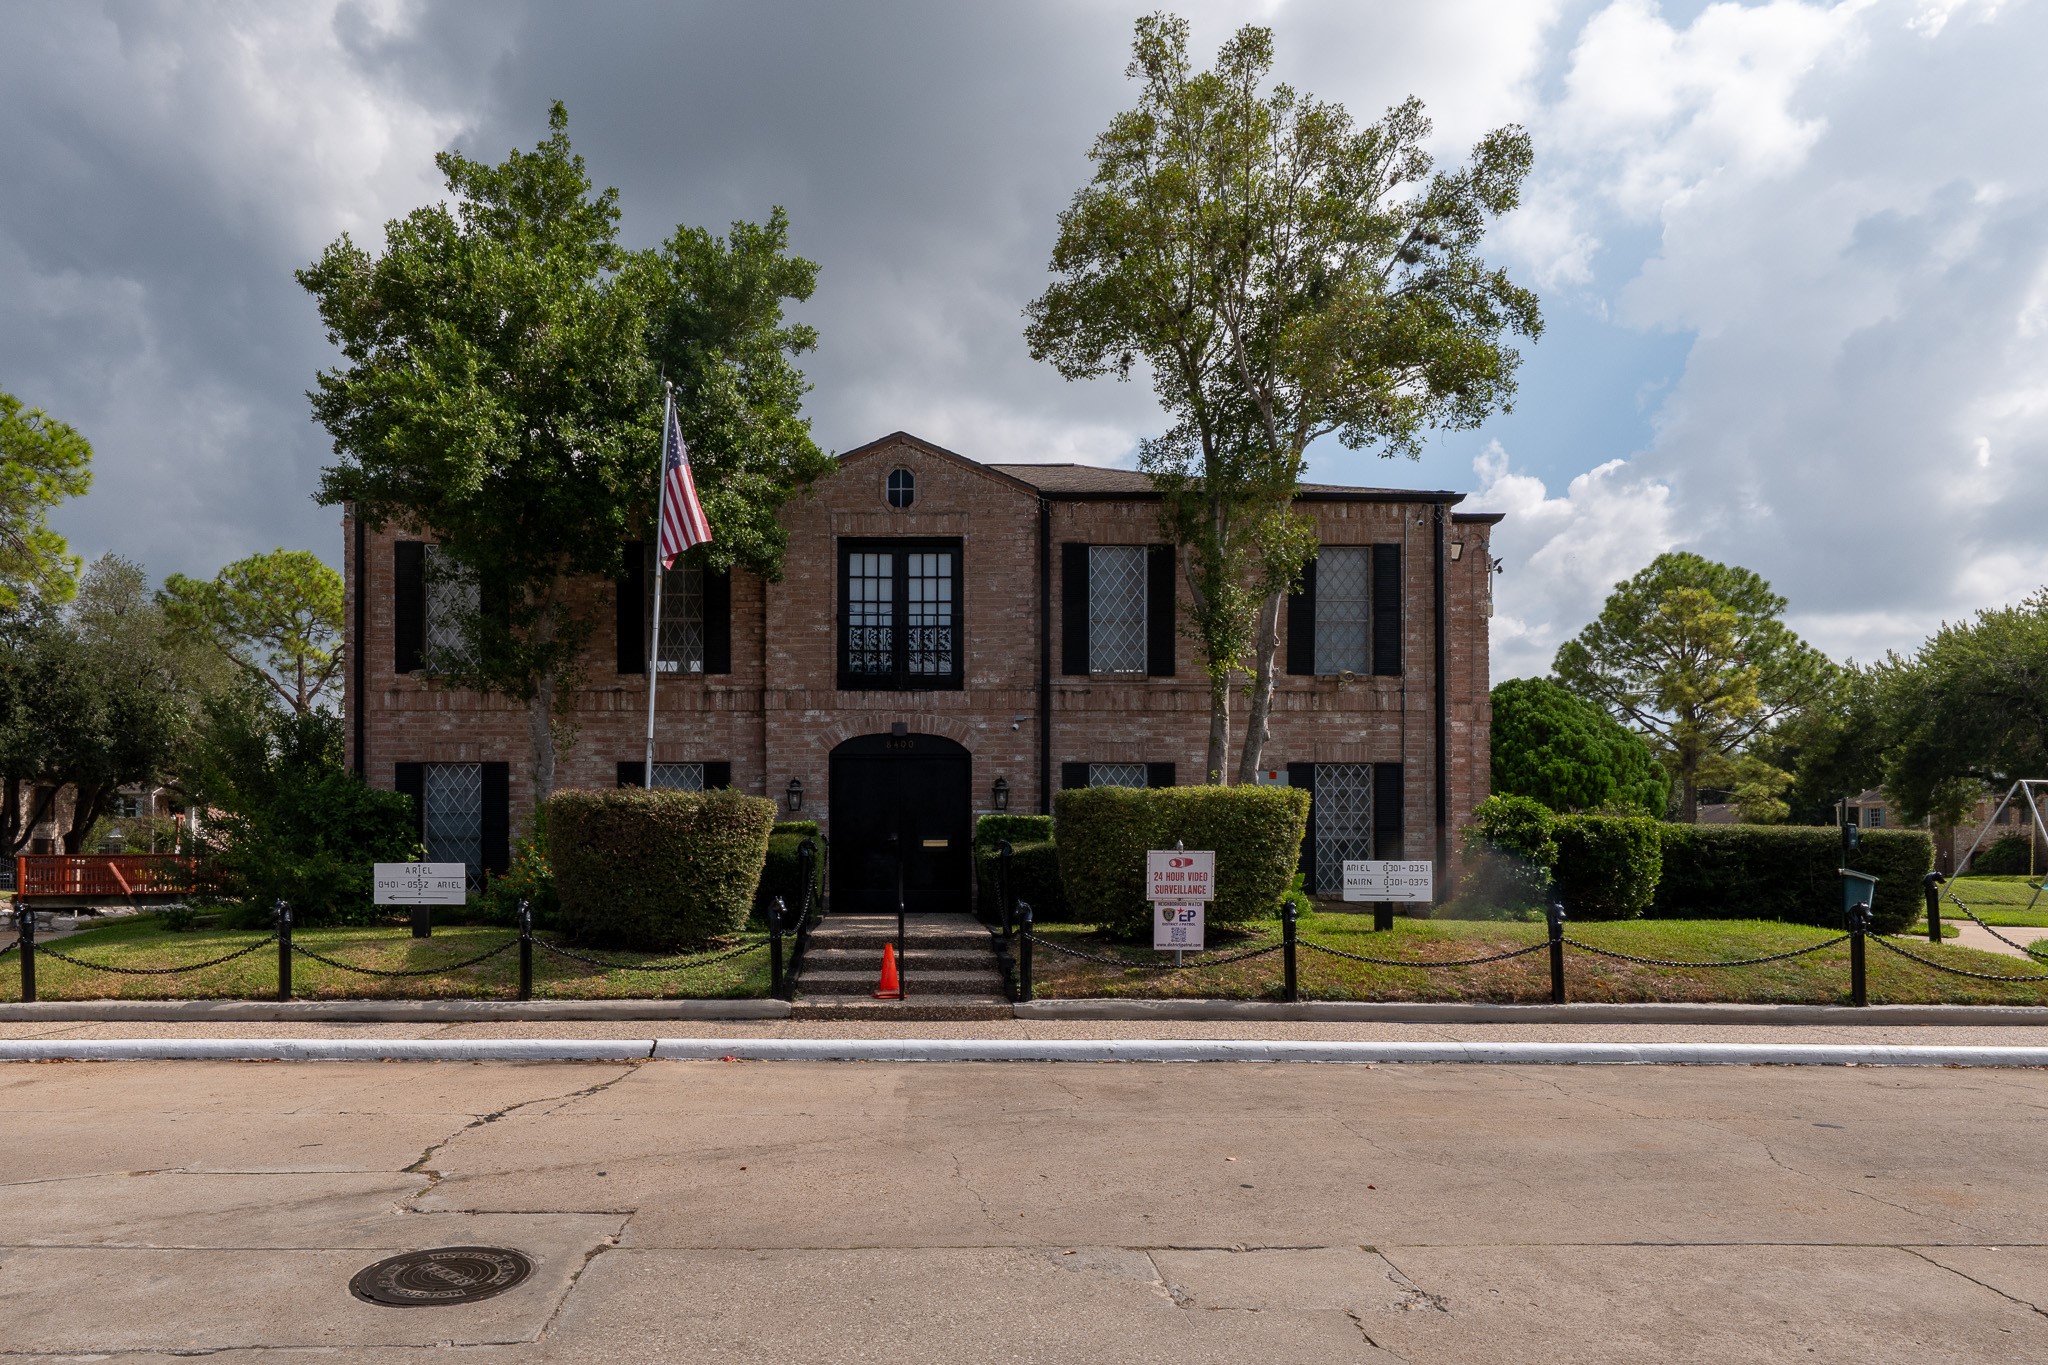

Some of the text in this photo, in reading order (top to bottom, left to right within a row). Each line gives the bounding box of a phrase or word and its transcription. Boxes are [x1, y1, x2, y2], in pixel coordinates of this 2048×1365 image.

[405, 866, 433, 875] ARIEL
[1346, 864, 1371, 872] ARIEL
[1153, 871, 1208, 882] 24 HOUR VIDEO
[437, 880, 461, 889] ARIEL
[1346, 878, 1373, 886] NAIRN
[1154, 884, 1207, 895] SURVEILLANCE
